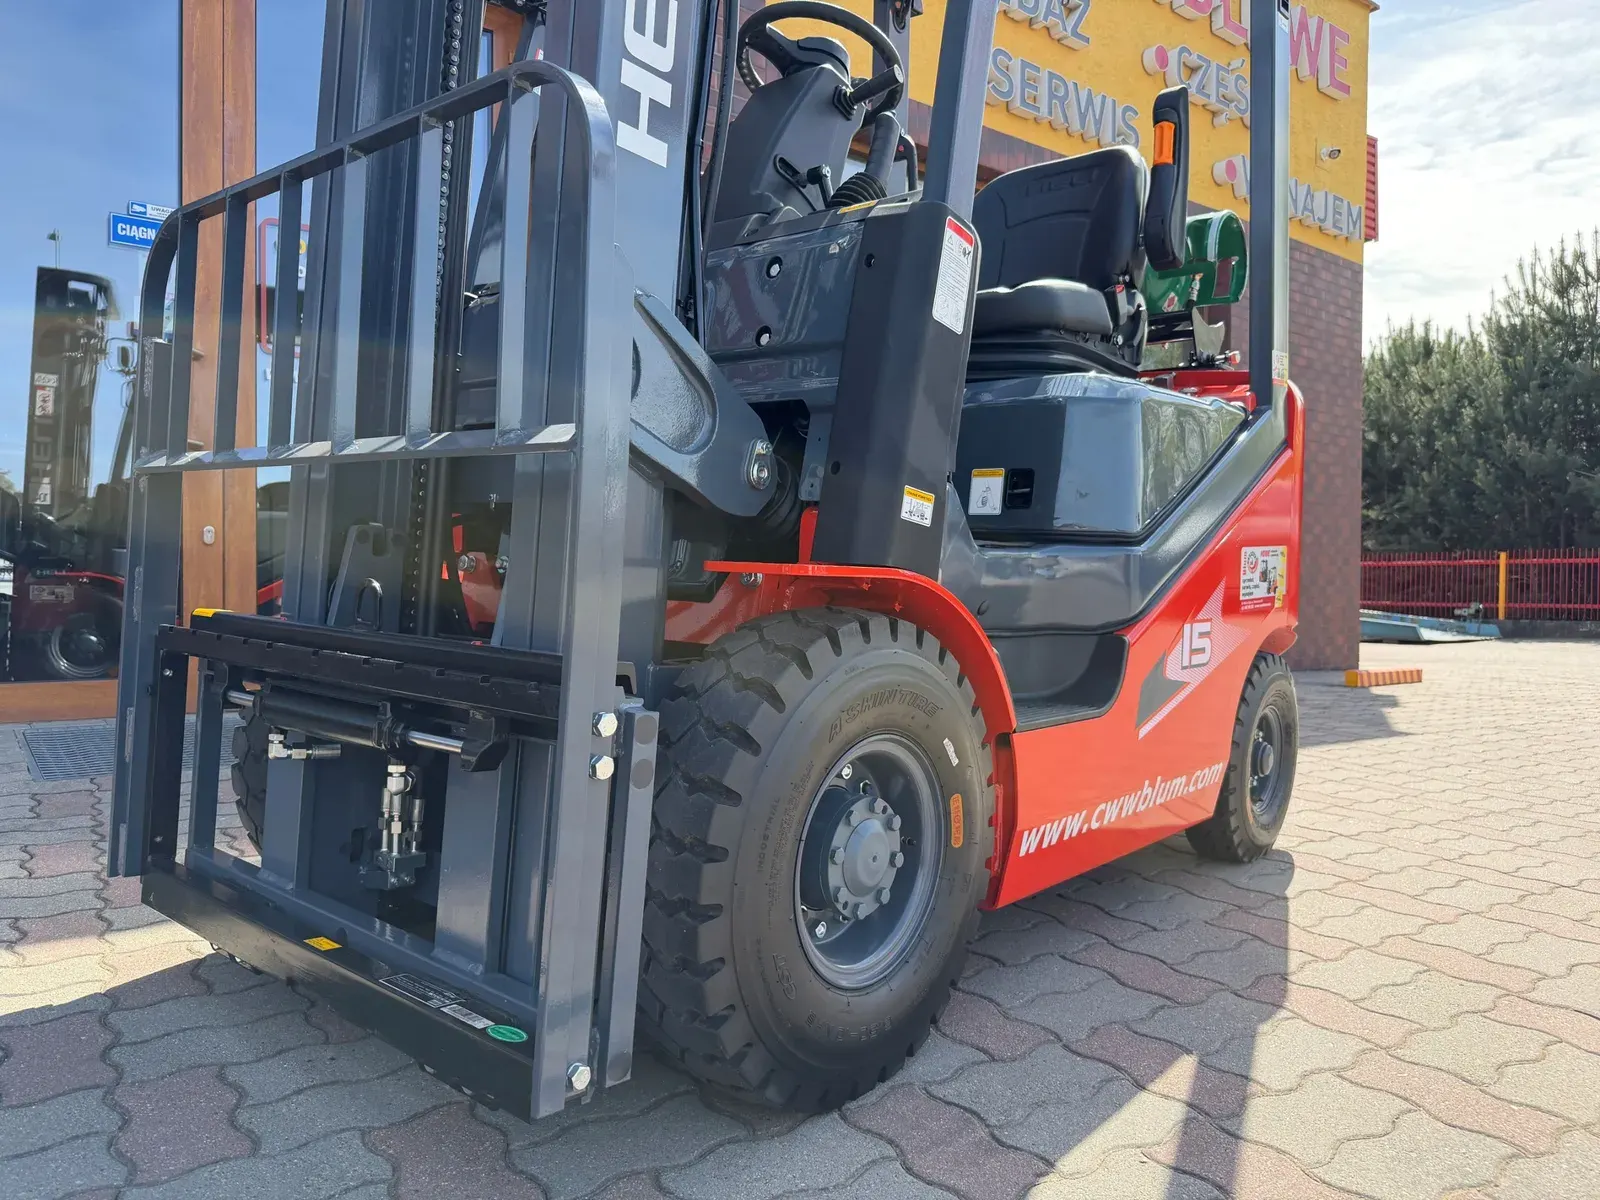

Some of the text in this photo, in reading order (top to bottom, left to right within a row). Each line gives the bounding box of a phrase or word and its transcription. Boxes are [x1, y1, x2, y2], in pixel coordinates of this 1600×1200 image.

[988, 46, 1140, 150] SERWIS
[1176, 45, 1250, 123] CZĘŚ
[117, 223, 160, 241] CIĄGN
[1181, 618, 1212, 670] 15
[1018, 762, 1224, 858] www.cwwblum.com
